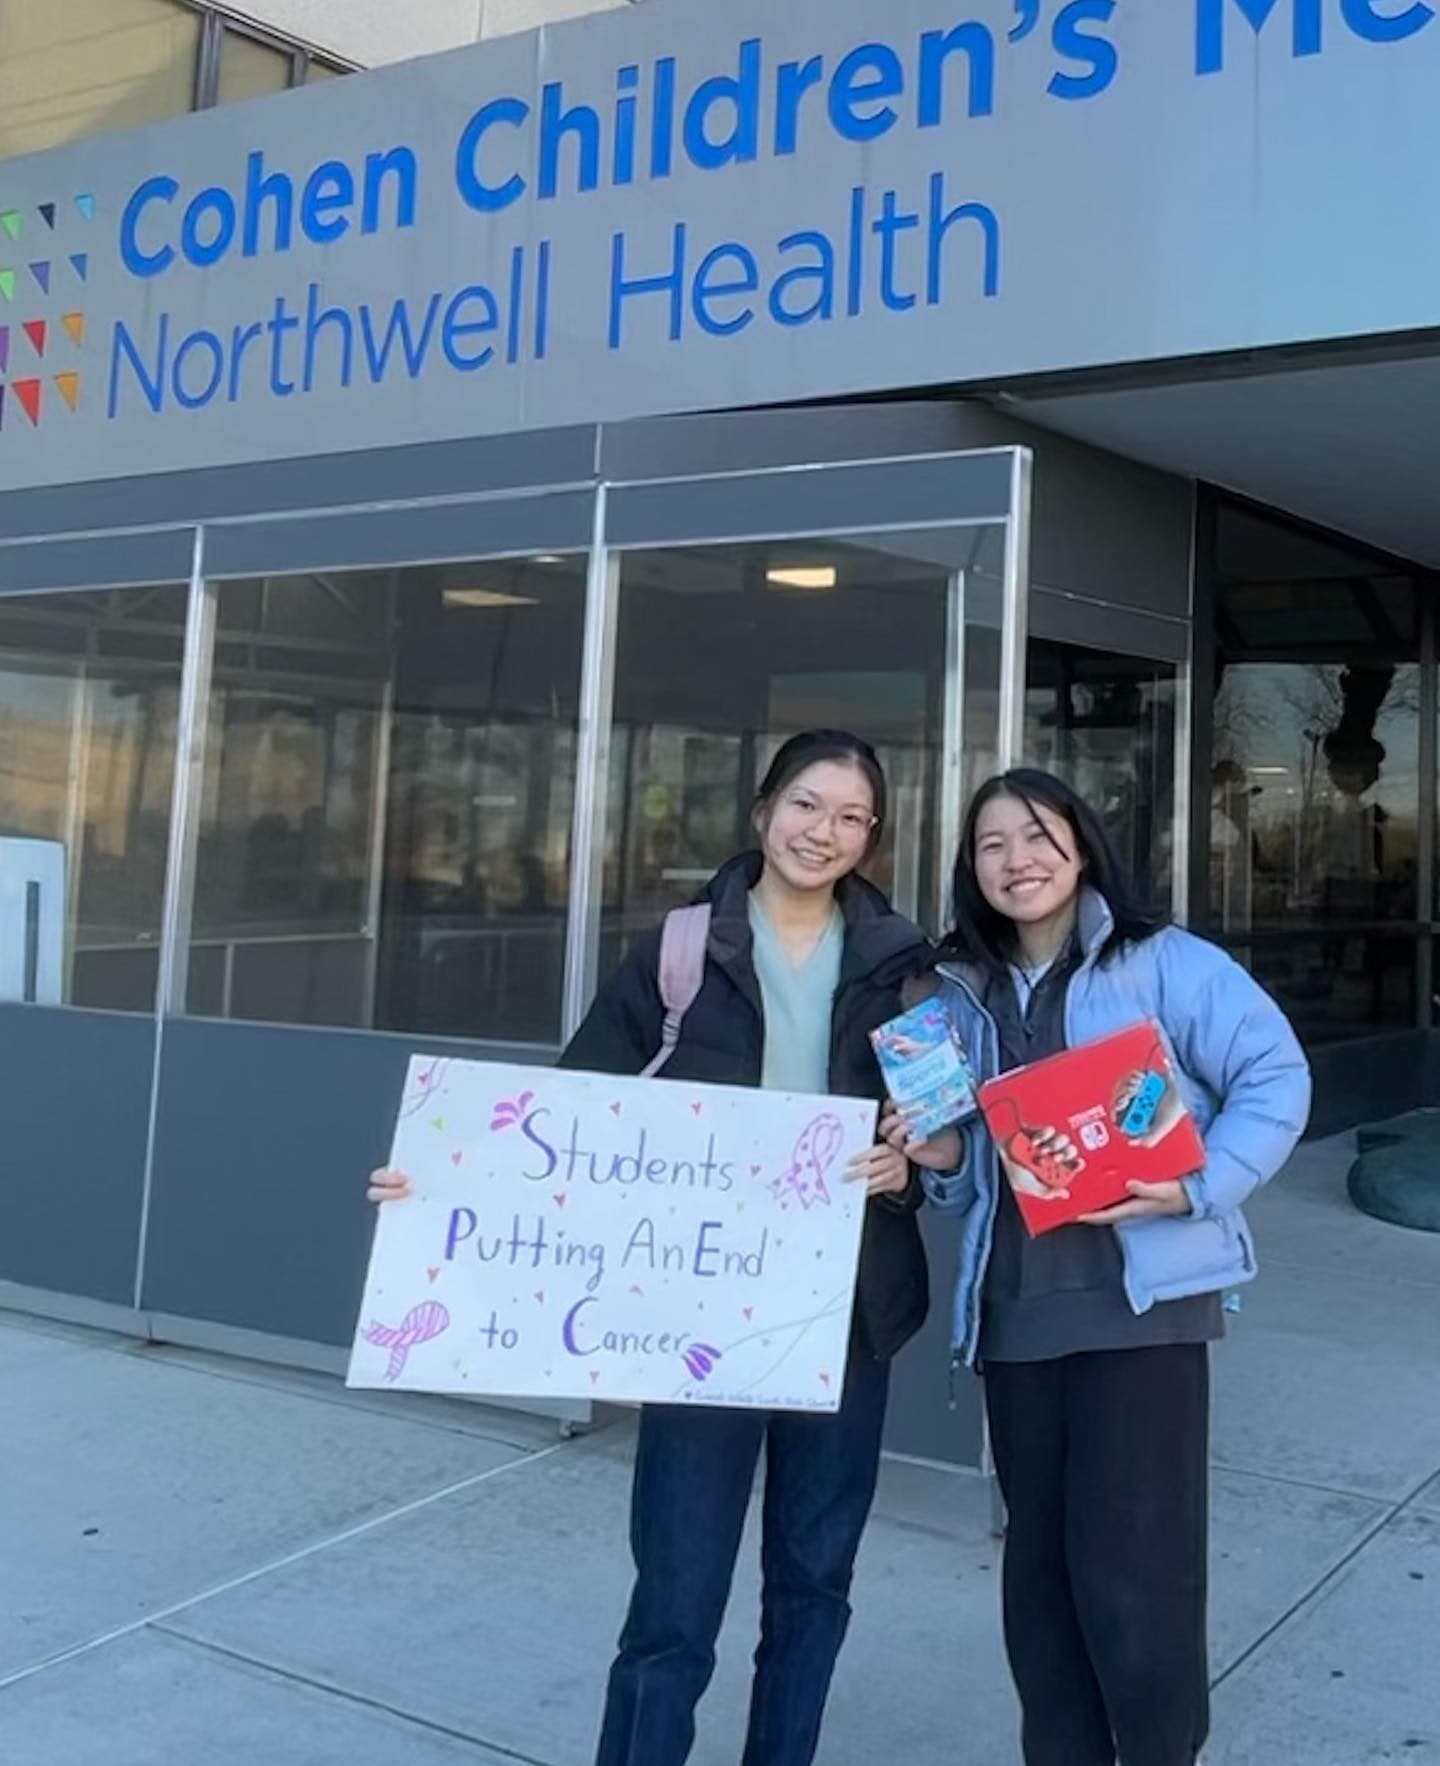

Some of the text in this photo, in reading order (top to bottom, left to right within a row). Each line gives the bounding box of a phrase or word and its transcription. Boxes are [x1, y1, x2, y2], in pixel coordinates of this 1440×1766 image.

[119, 146, 418, 279] Cohen
[455, 0, 1119, 214] Children's
[107, 172, 1000, 419] Northwell Health
[521, 1107, 736, 1192] Students
[444, 1207, 768, 1291] Putting An End
[479, 1296, 689, 1356] to Cancer
